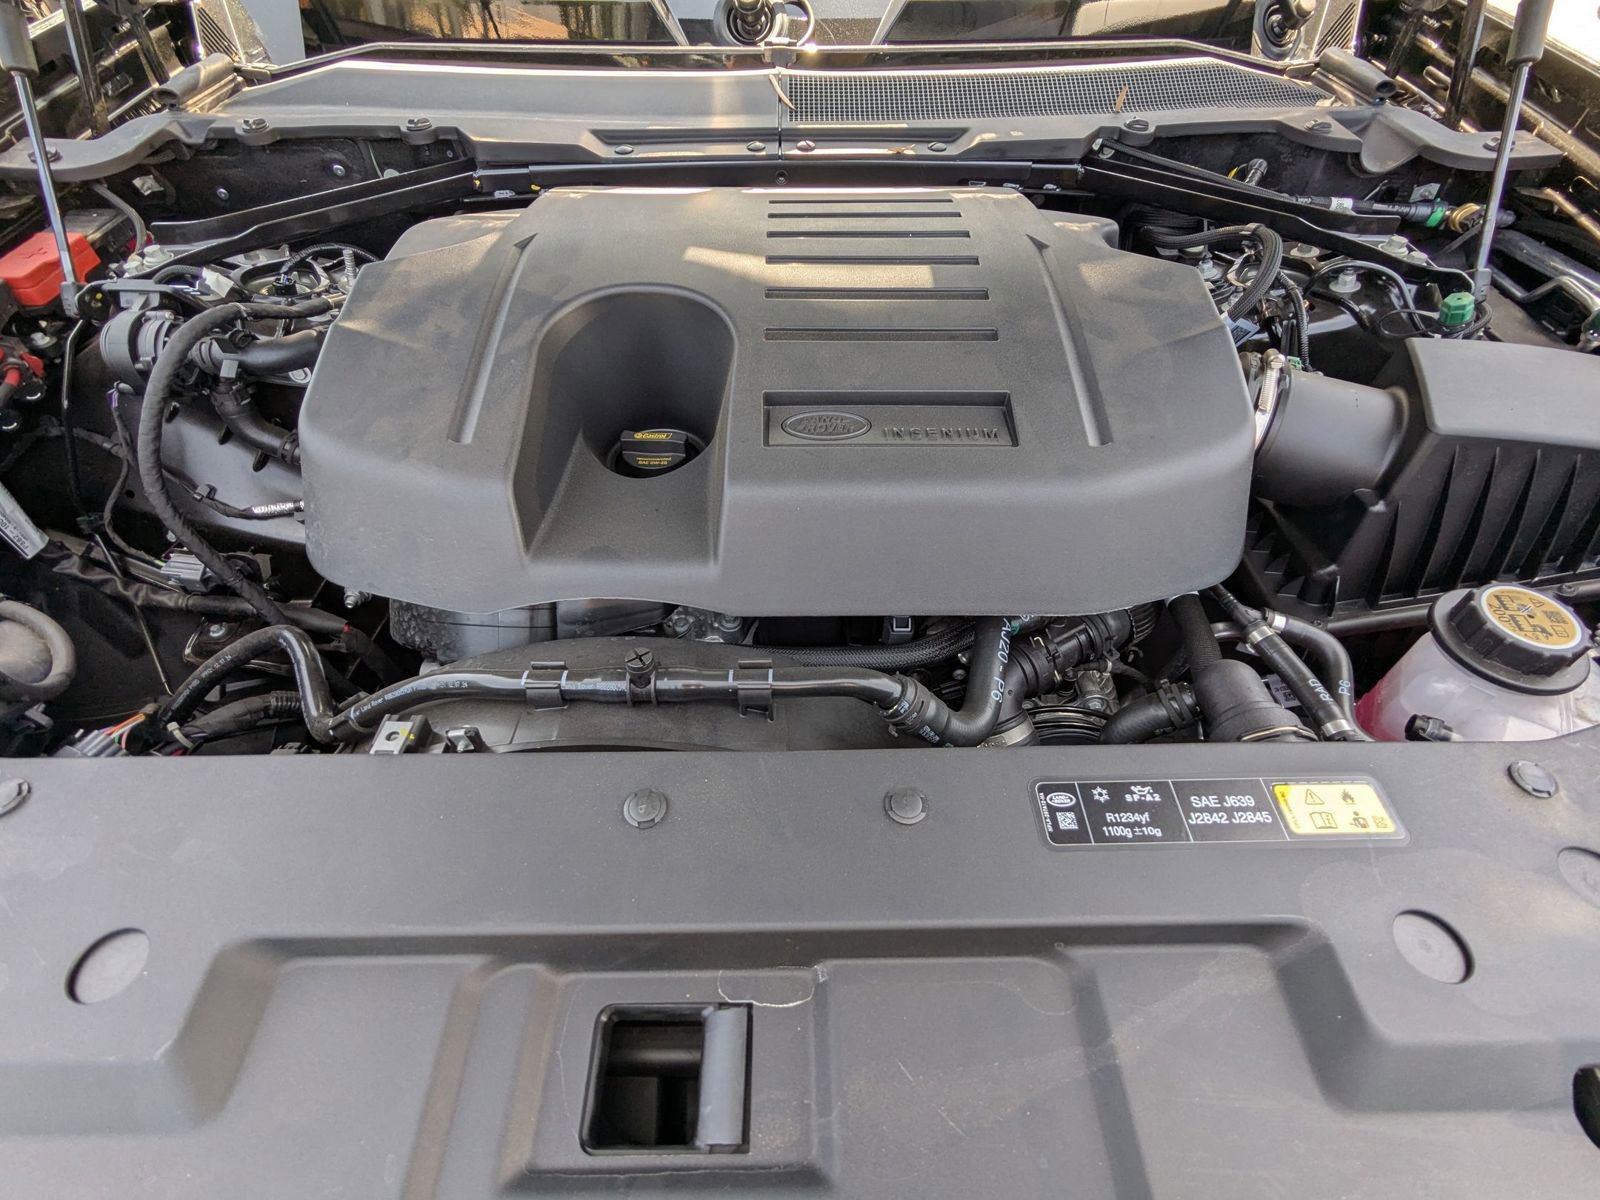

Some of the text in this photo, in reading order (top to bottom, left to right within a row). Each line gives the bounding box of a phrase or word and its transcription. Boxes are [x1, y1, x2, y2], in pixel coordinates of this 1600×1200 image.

[883, 427, 1000, 442] INGENIUM
[998, 618, 1012, 663] AJ20
[991, 676, 1006, 704] P6
[1338, 679, 1351, 696] P6
[1124, 793, 1162, 802] SP-A2
[1190, 795, 1255, 808] SAE J639
[1105, 812, 1150, 825] R1234yf
[1188, 811, 1272, 824] J2842 J2845
[1102, 826, 1133, 838] 1100g
